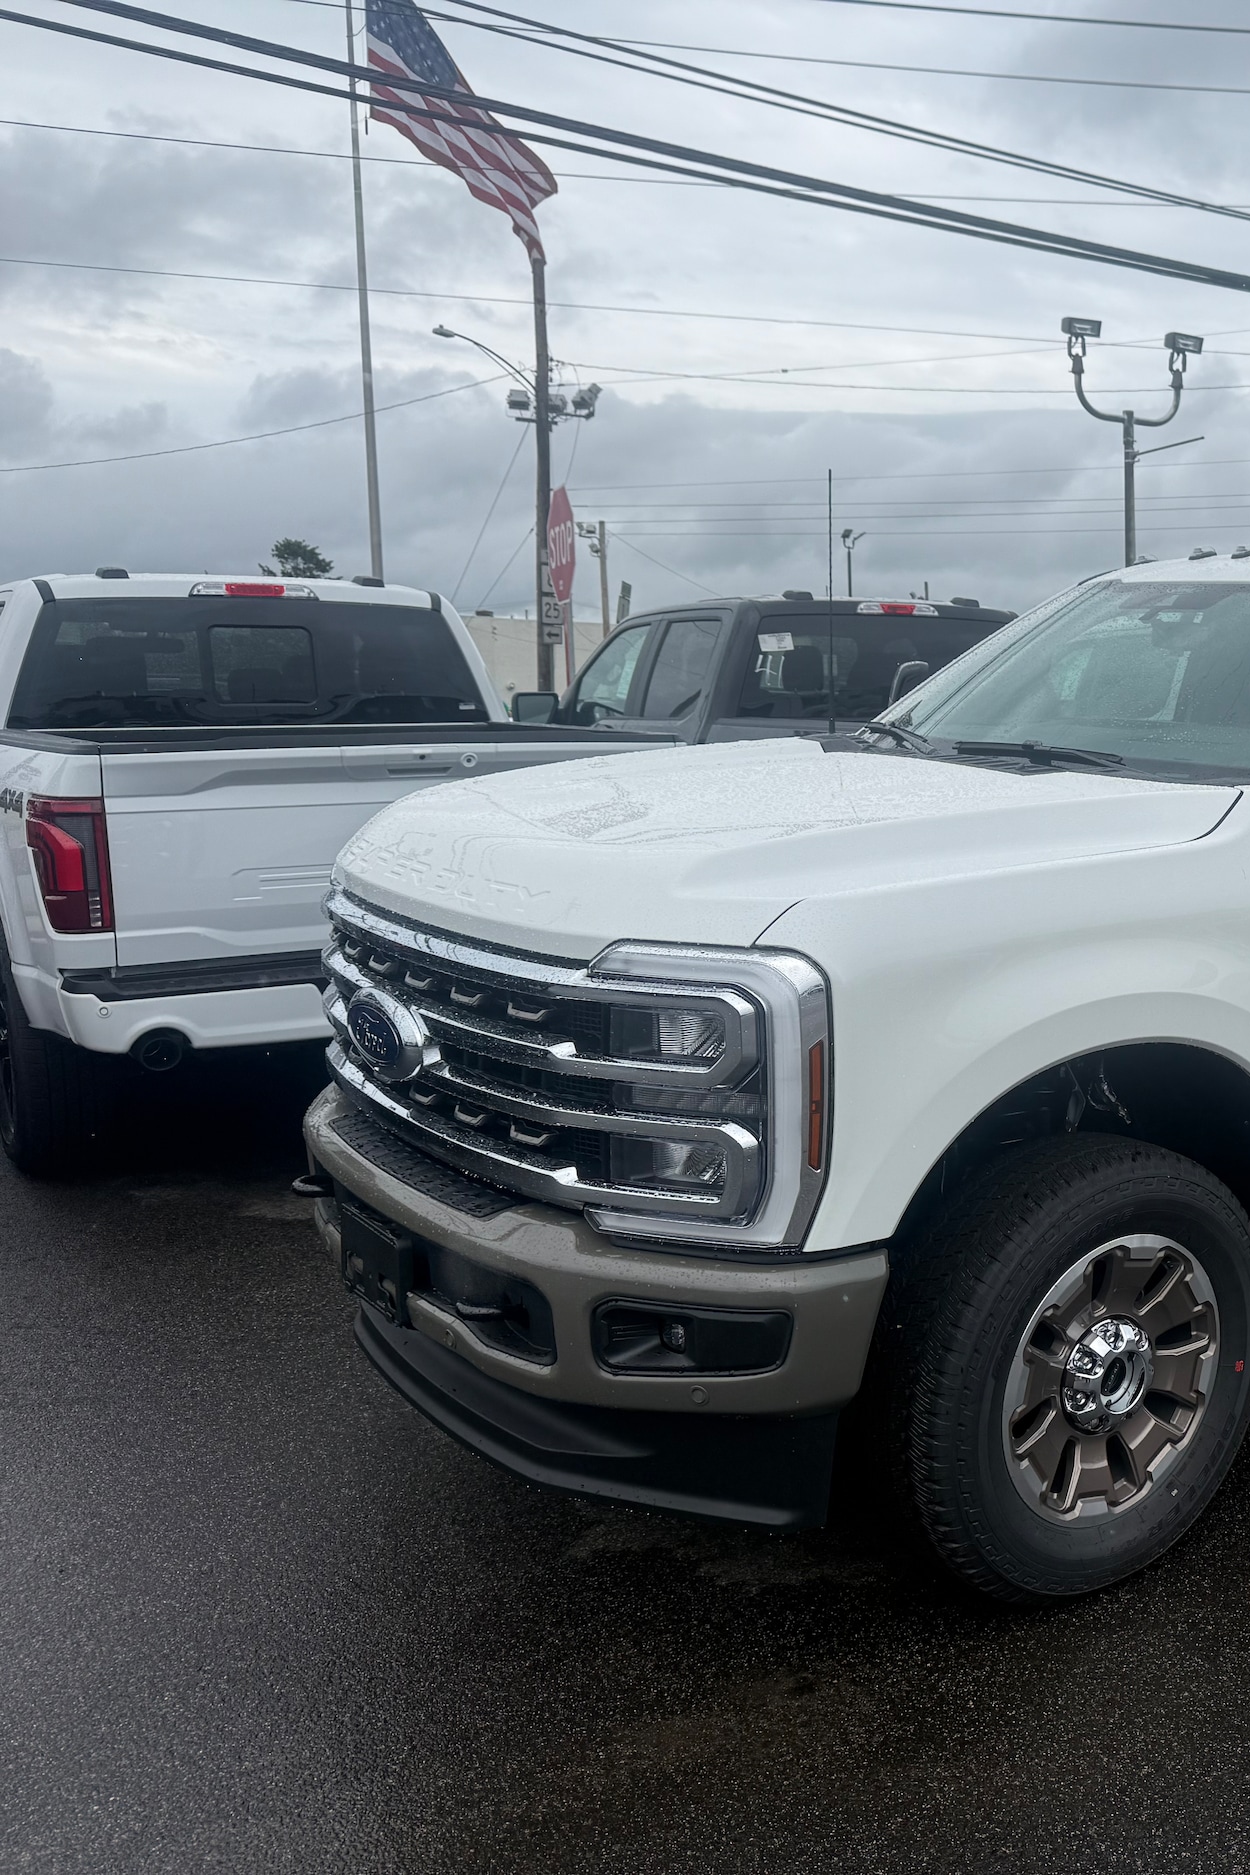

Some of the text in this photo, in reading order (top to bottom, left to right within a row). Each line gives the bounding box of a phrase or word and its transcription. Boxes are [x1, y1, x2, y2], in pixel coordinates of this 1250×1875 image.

[549, 520, 573, 569] STOP
[544, 602, 560, 619] 25
[355, 1011, 389, 1056] Ford
